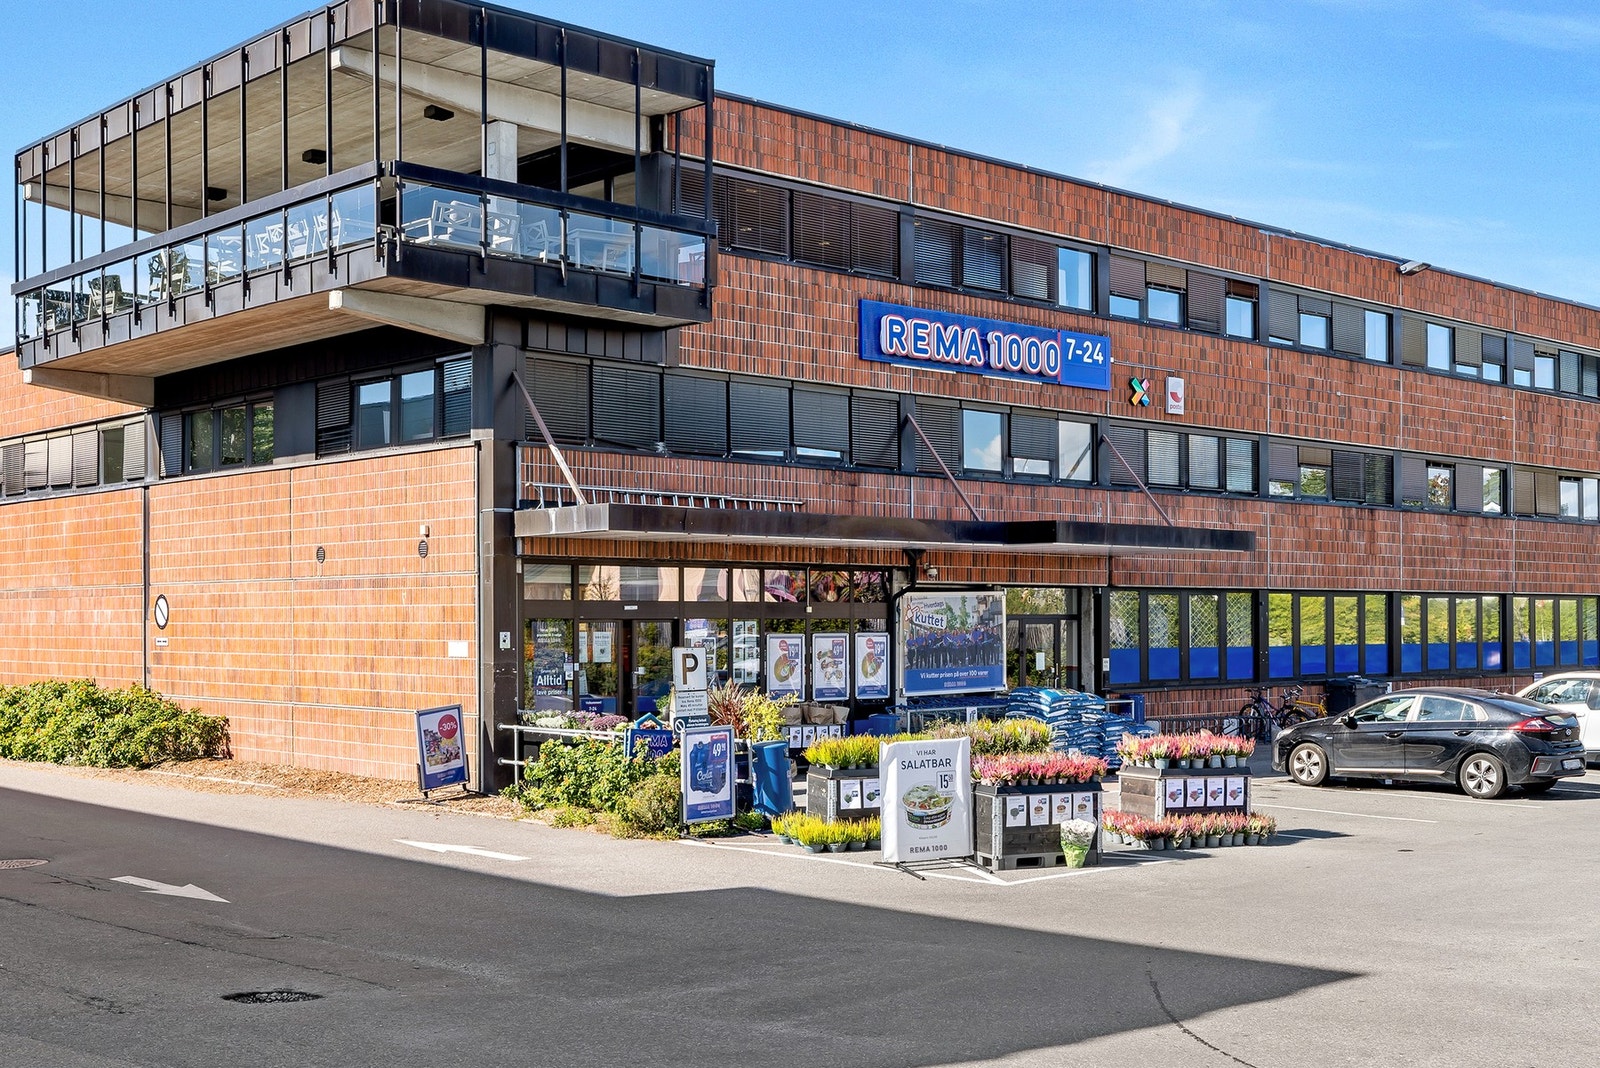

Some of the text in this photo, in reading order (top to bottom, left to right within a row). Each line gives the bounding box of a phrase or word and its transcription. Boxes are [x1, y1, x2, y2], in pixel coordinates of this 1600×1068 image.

[880, 314, 1060, 377] REMA 1000
[1066, 338, 1104, 364] 7-24
[915, 611, 944, 627] kuttet
[682, 653, 698, 685] P
[939, 671, 953, 679] prisen
[953, 670, 960, 679] på
[536, 675, 562, 686] Alltid
[440, 721, 457, 731] -30%
[713, 743, 721, 757] 49
[901, 758, 952, 770] SALATBAR
[697, 769, 713, 781] Cola
[940, 774, 949, 789] 15
[932, 844, 948, 852] 1000
